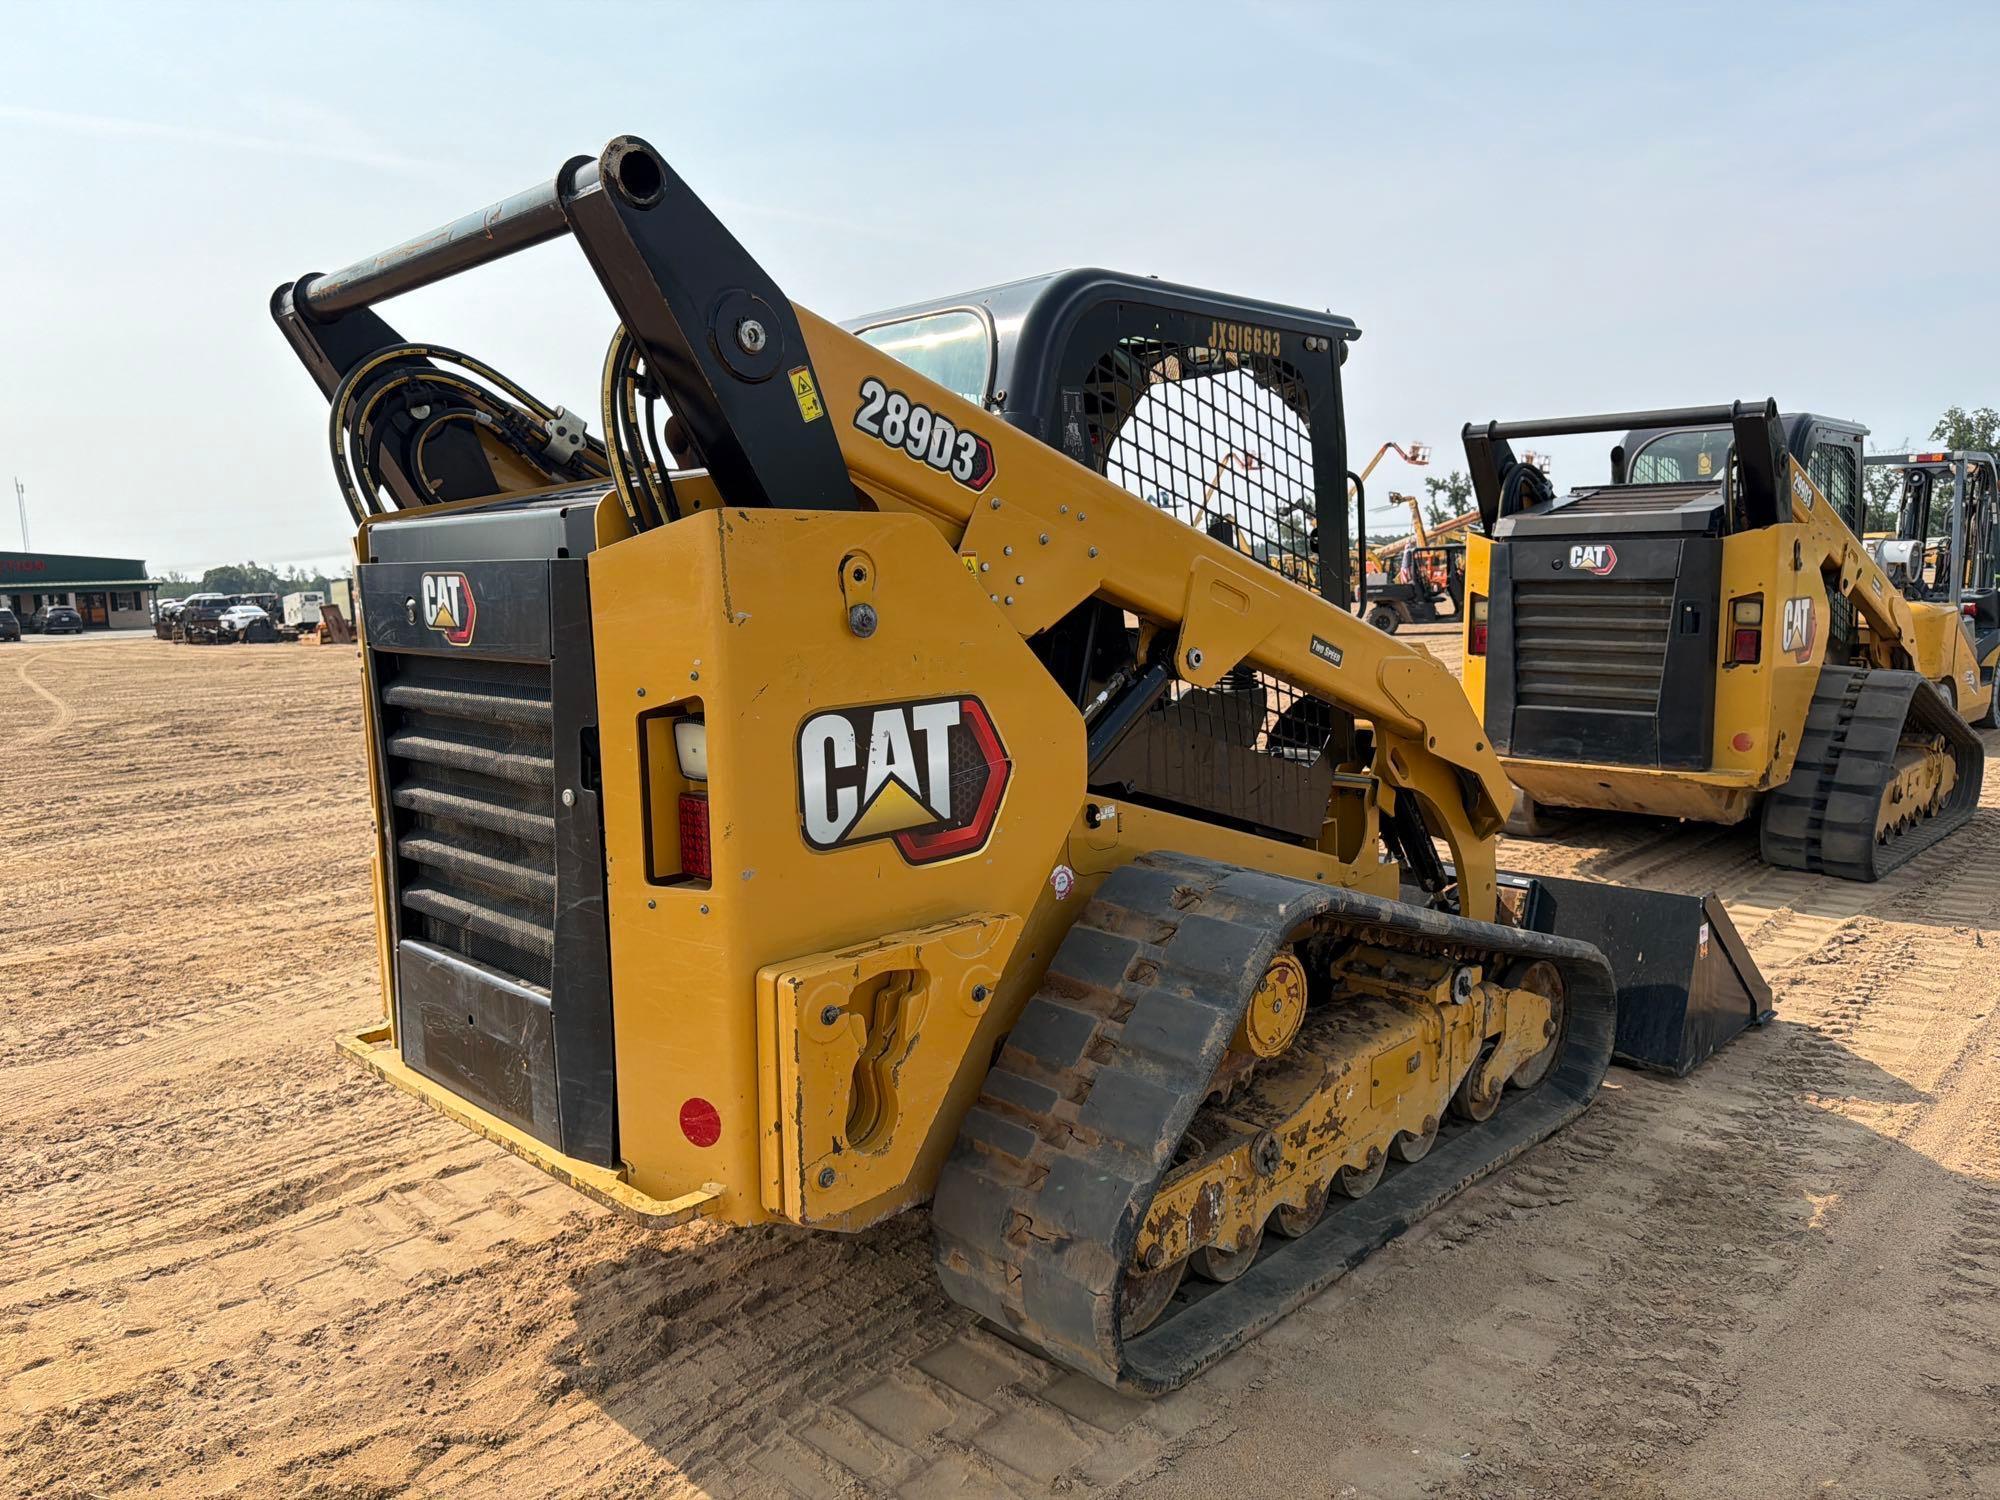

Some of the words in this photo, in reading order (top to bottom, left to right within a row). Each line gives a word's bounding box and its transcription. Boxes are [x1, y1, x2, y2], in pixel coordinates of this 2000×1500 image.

[1208, 321, 1281, 357] JX916693
[855, 380, 977, 481] 289D3
[1570, 546, 1606, 568] CAT
[422, 575, 460, 627] CAT
[1783, 599, 1811, 651] CAT
[801, 701, 960, 844] CAT
